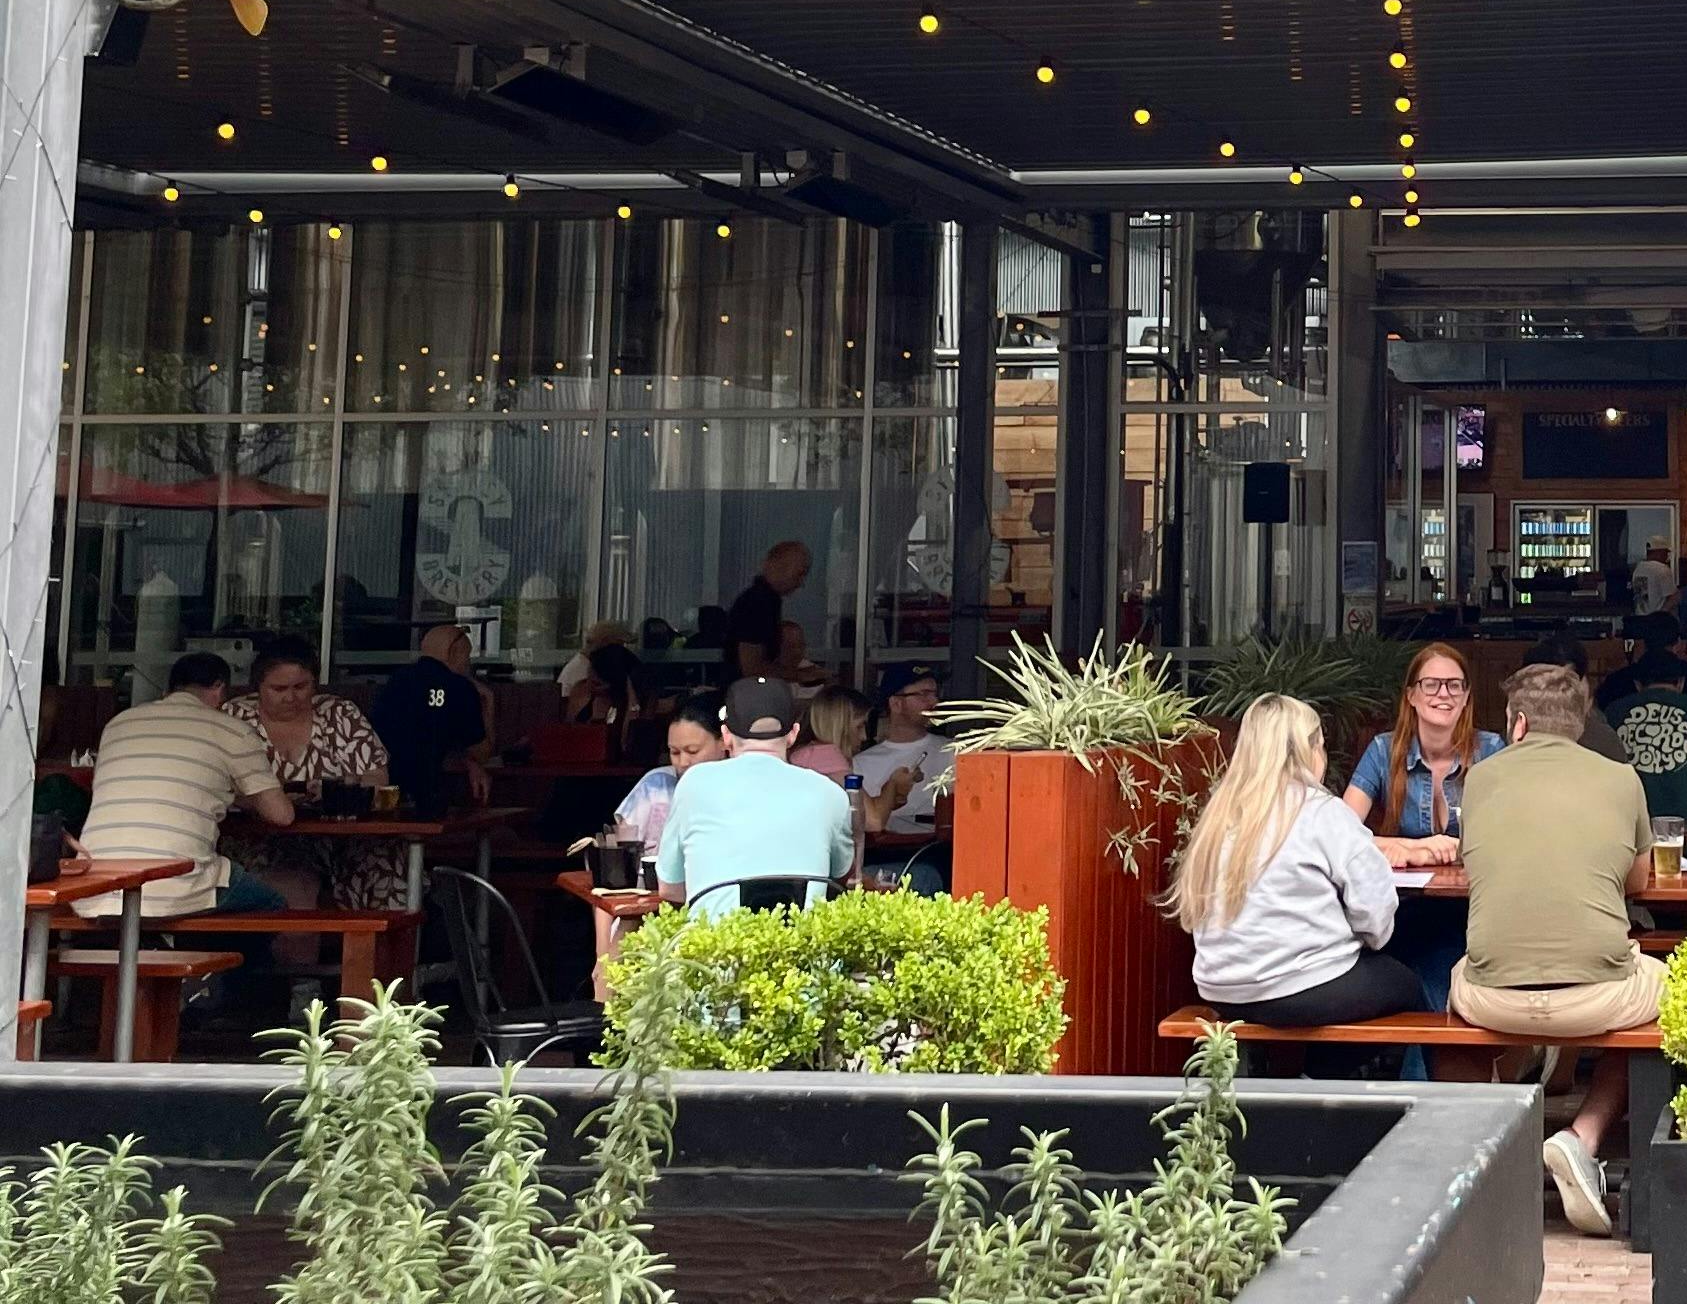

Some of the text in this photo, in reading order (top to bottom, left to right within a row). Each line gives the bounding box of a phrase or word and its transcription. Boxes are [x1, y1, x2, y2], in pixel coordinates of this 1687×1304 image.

[428, 688, 445, 707] 38
[1624, 702, 1686, 724] DEUS
[1628, 744, 1687, 773] TOKYO
